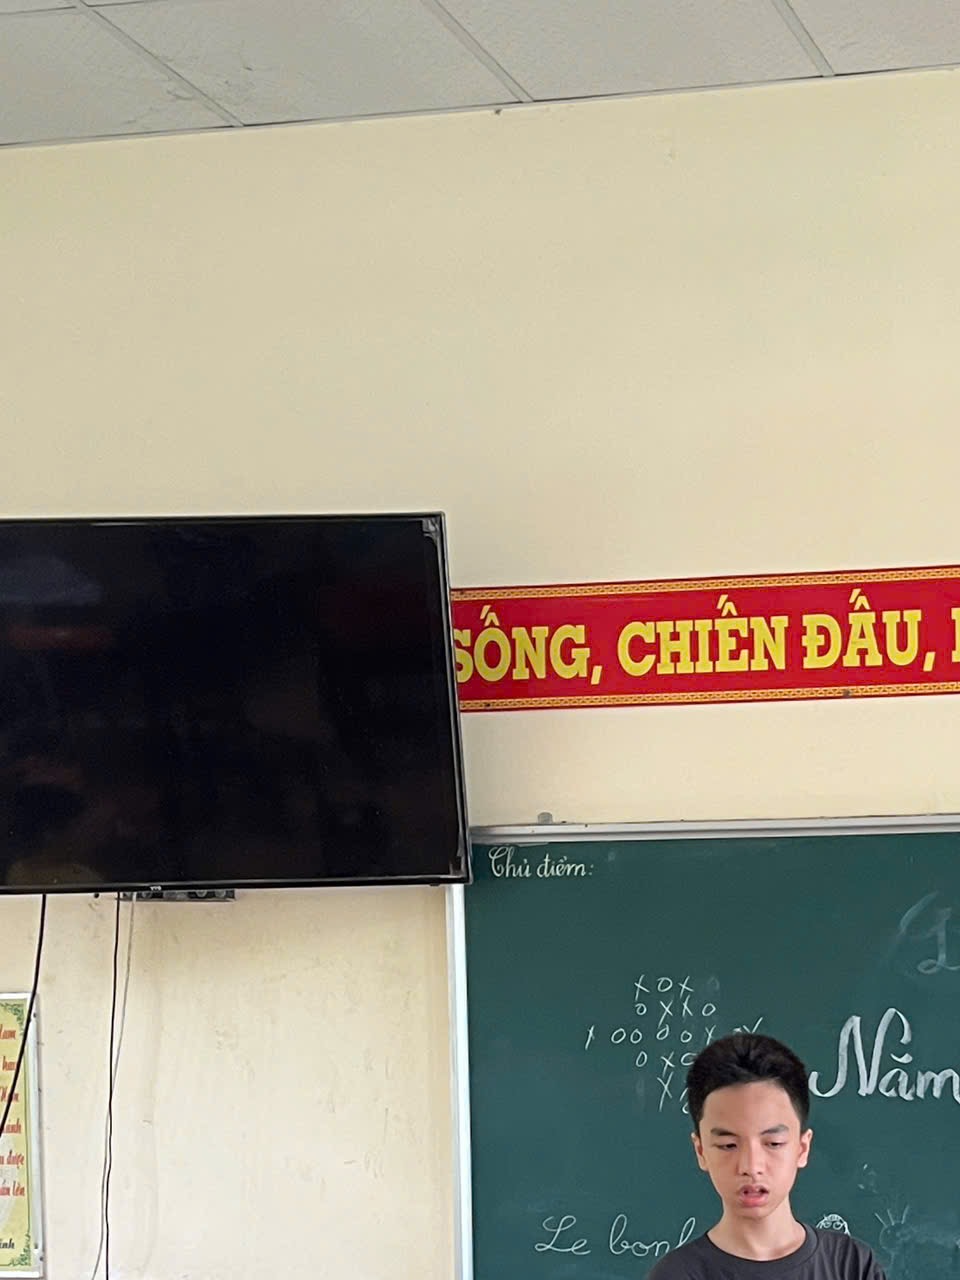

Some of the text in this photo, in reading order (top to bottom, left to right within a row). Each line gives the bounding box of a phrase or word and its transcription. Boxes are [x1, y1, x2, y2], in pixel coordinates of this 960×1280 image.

[453, 603, 603, 685] SỐNG,
[618, 594, 788, 676] CHIẾN
[802, 588, 936, 672] ĐẤU,
[534, 1215, 591, 1255] Le
